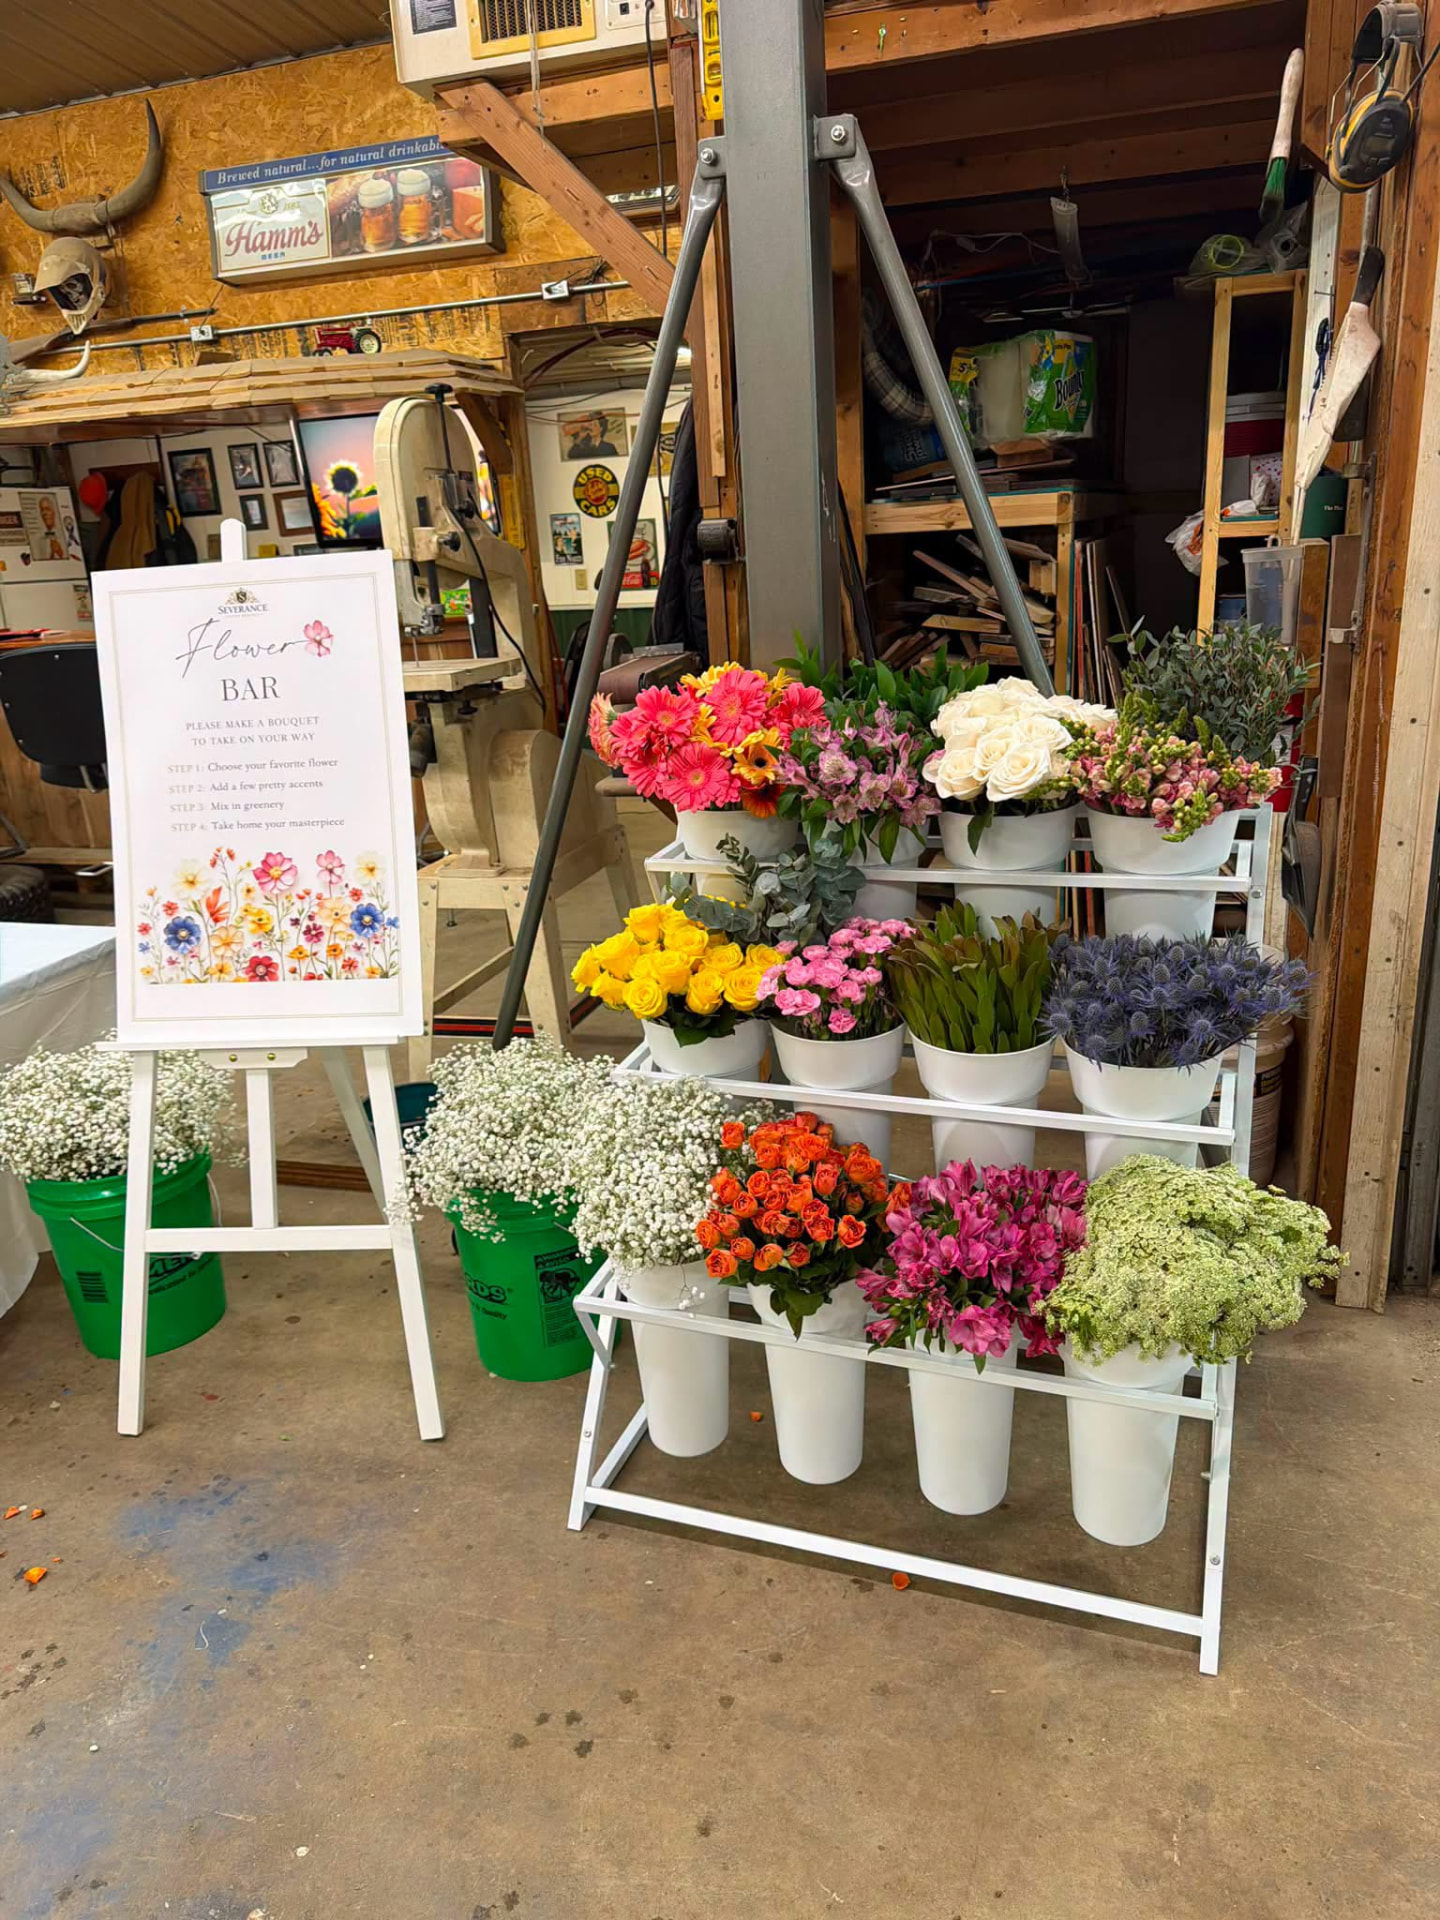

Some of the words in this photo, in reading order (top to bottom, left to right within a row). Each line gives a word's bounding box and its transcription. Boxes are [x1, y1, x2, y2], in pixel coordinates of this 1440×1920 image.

[217, 167, 260, 184] Brewed
[340, 147, 384, 165] natural
[388, 139, 446, 158] drinkabi
[224, 219, 324, 257] Hamm's
[578, 467, 613, 485] USED
[580, 498, 616, 517] CARS
[217, 603, 268, 615] SEVERANCE
[175, 617, 309, 678] Flower
[221, 676, 280, 702] BAR
[186, 719, 222, 731] PLEASE
[225, 719, 254, 729] MAKE
[257, 718, 264, 728] A
[268, 716, 320, 728] BOUQUET
[192, 737, 206, 746] TO
[211, 736, 235, 745] TAKE
[239, 735, 255, 744] ON
[258, 733, 288, 743] YOUR
[291, 732, 316, 742] WAY
[167, 764, 193, 774] STEP
[207, 762, 243, 773] Choose
[244, 762, 266, 773] your
[269, 759, 306, 769] favorite
[308, 758, 338, 768] flower
[169, 784, 194, 794] STEP
[209, 783, 229, 792] Add
[239, 782, 256, 791] few
[258, 781, 287, 792] pretty
[288, 780, 324, 789] accents
[170, 803, 195, 813] STEP
[210, 802, 230, 811] Mix
[232, 802, 241, 810] in
[243, 801, 285, 812] greenery
[171, 823, 197, 832] STEP
[210, 821, 234, 831] Take
[236, 819, 262, 830] home
[264, 820, 286, 831] your
[288, 818, 345, 829] masterpiece
